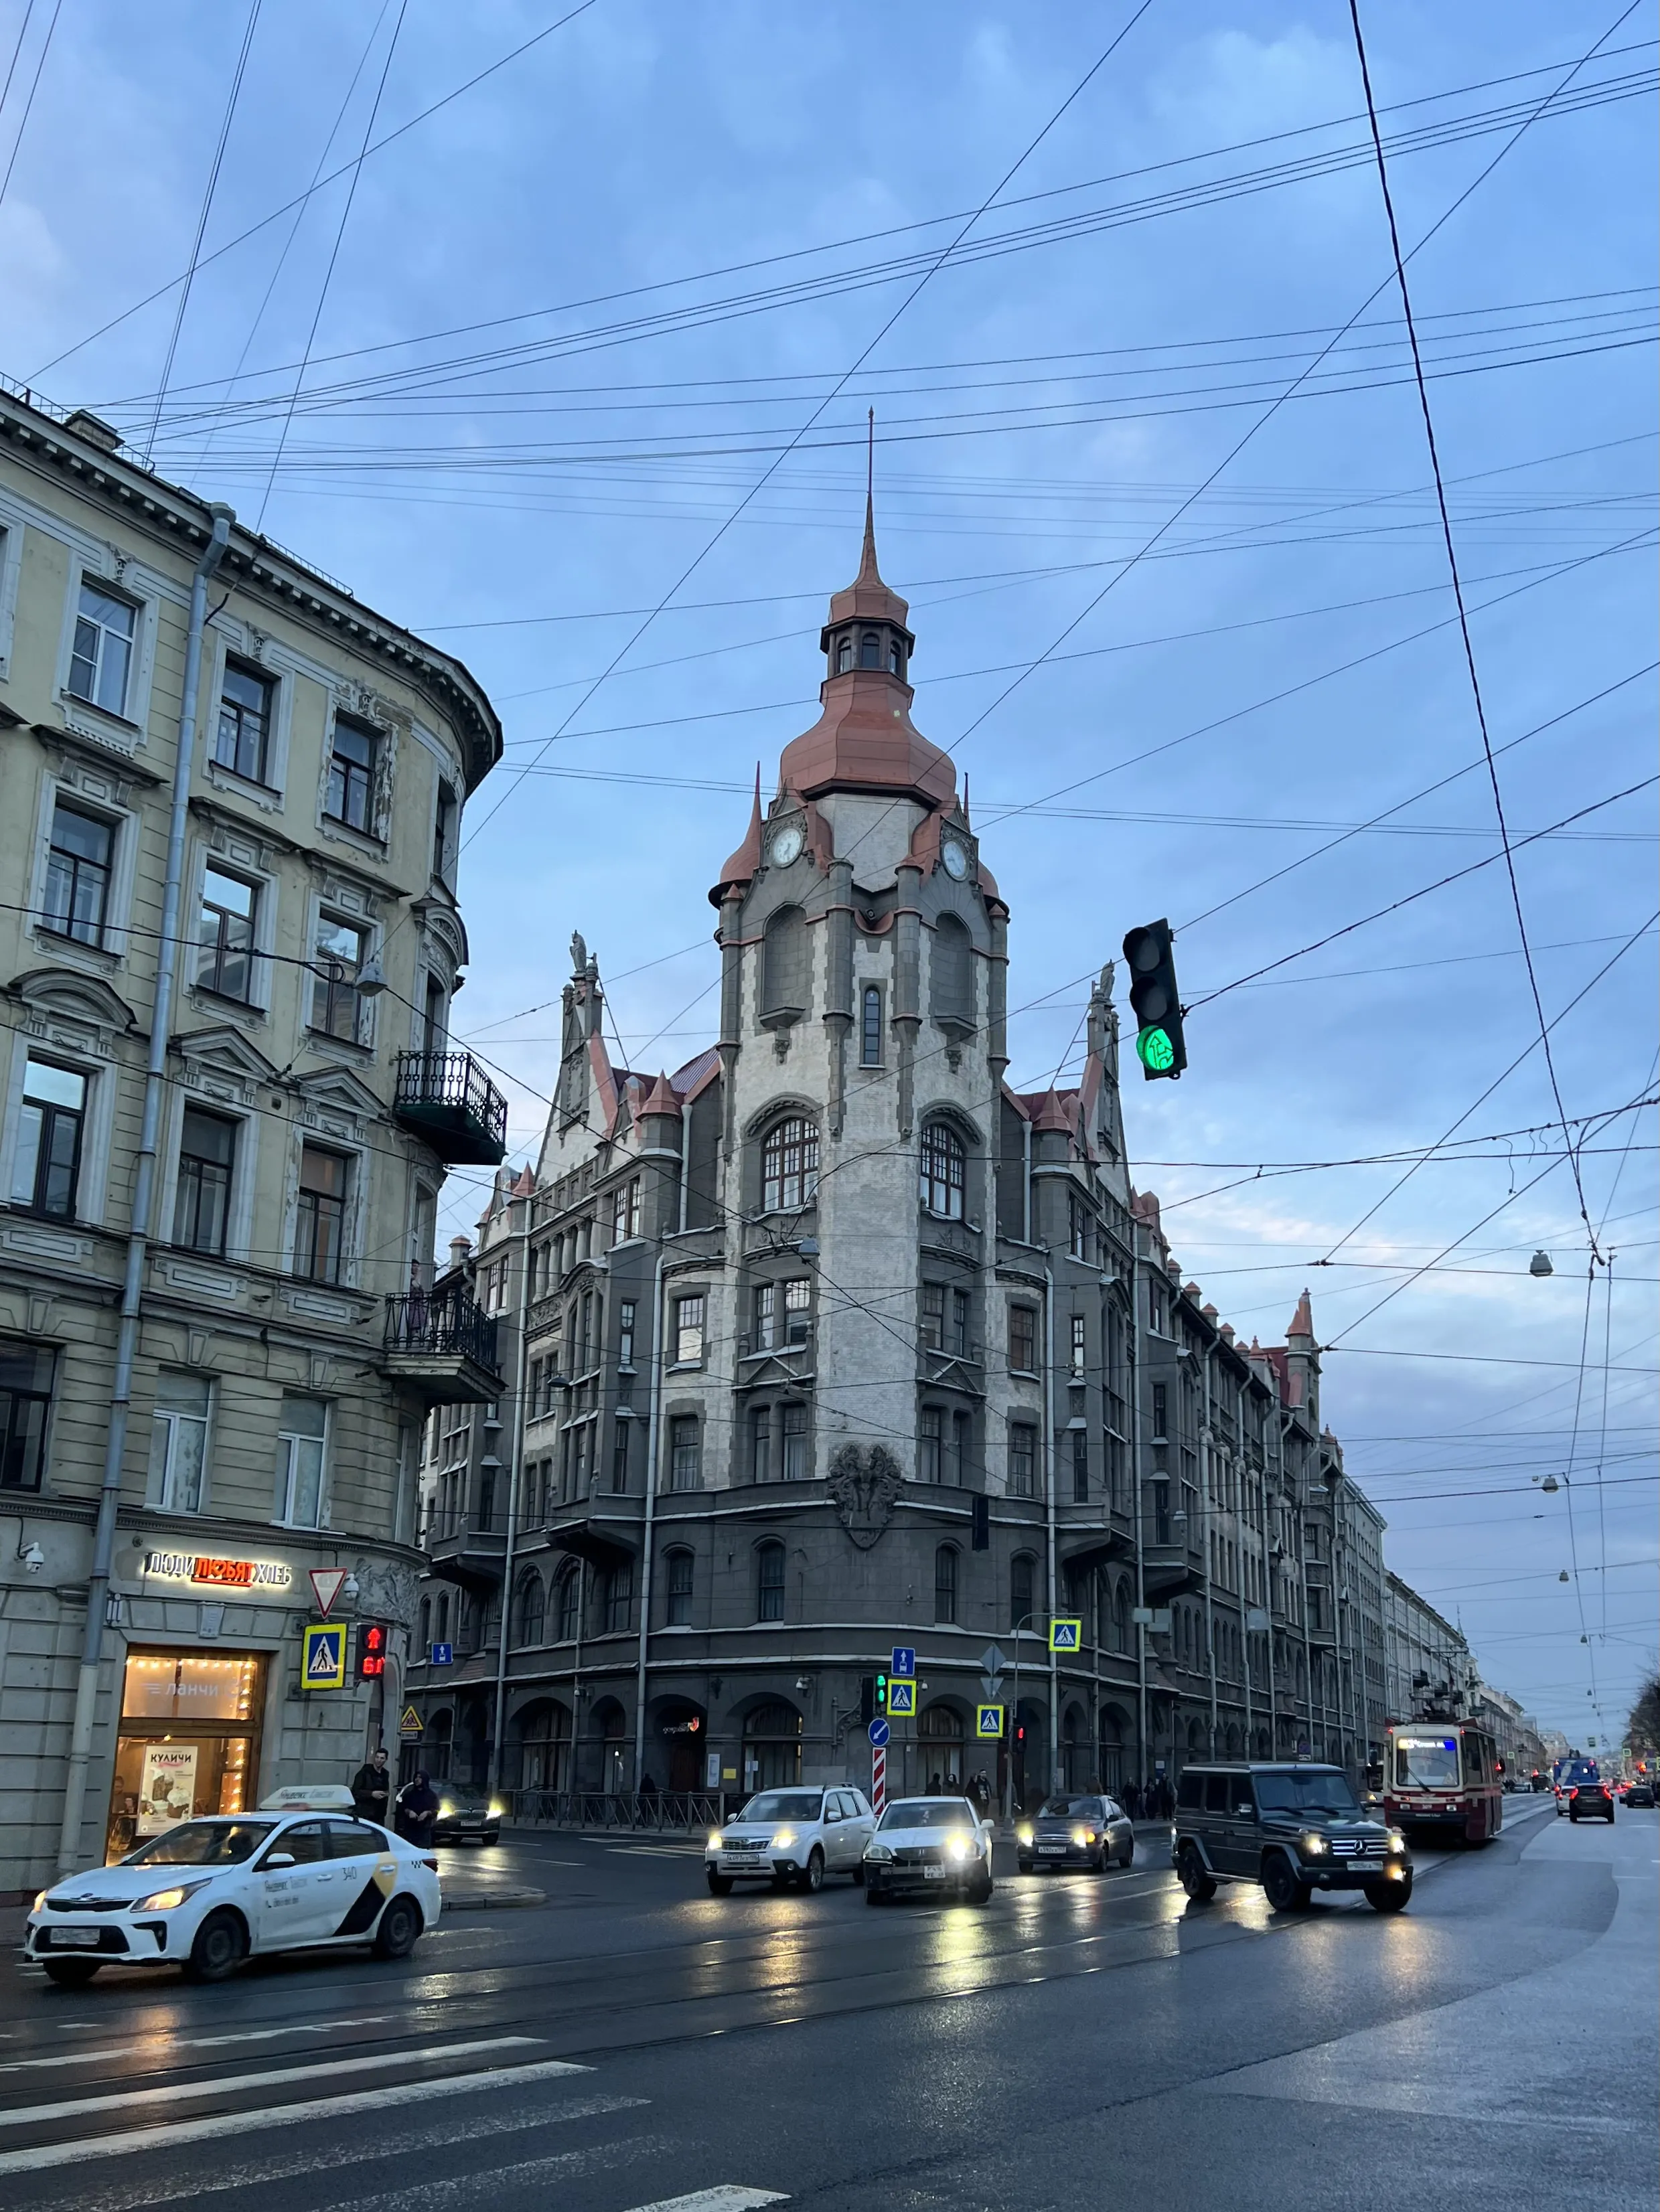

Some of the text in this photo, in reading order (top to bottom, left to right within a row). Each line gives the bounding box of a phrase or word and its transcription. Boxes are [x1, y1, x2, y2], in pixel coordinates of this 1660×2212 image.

[145, 1553, 292, 1584] ЛЮДИ ЛЮБЯТ ХЛЕБ
[166, 1682, 218, 1696] ланчи
[151, 1753, 192, 1763] КУЛИЧИ
[342, 1866, 357, 1881] 340
